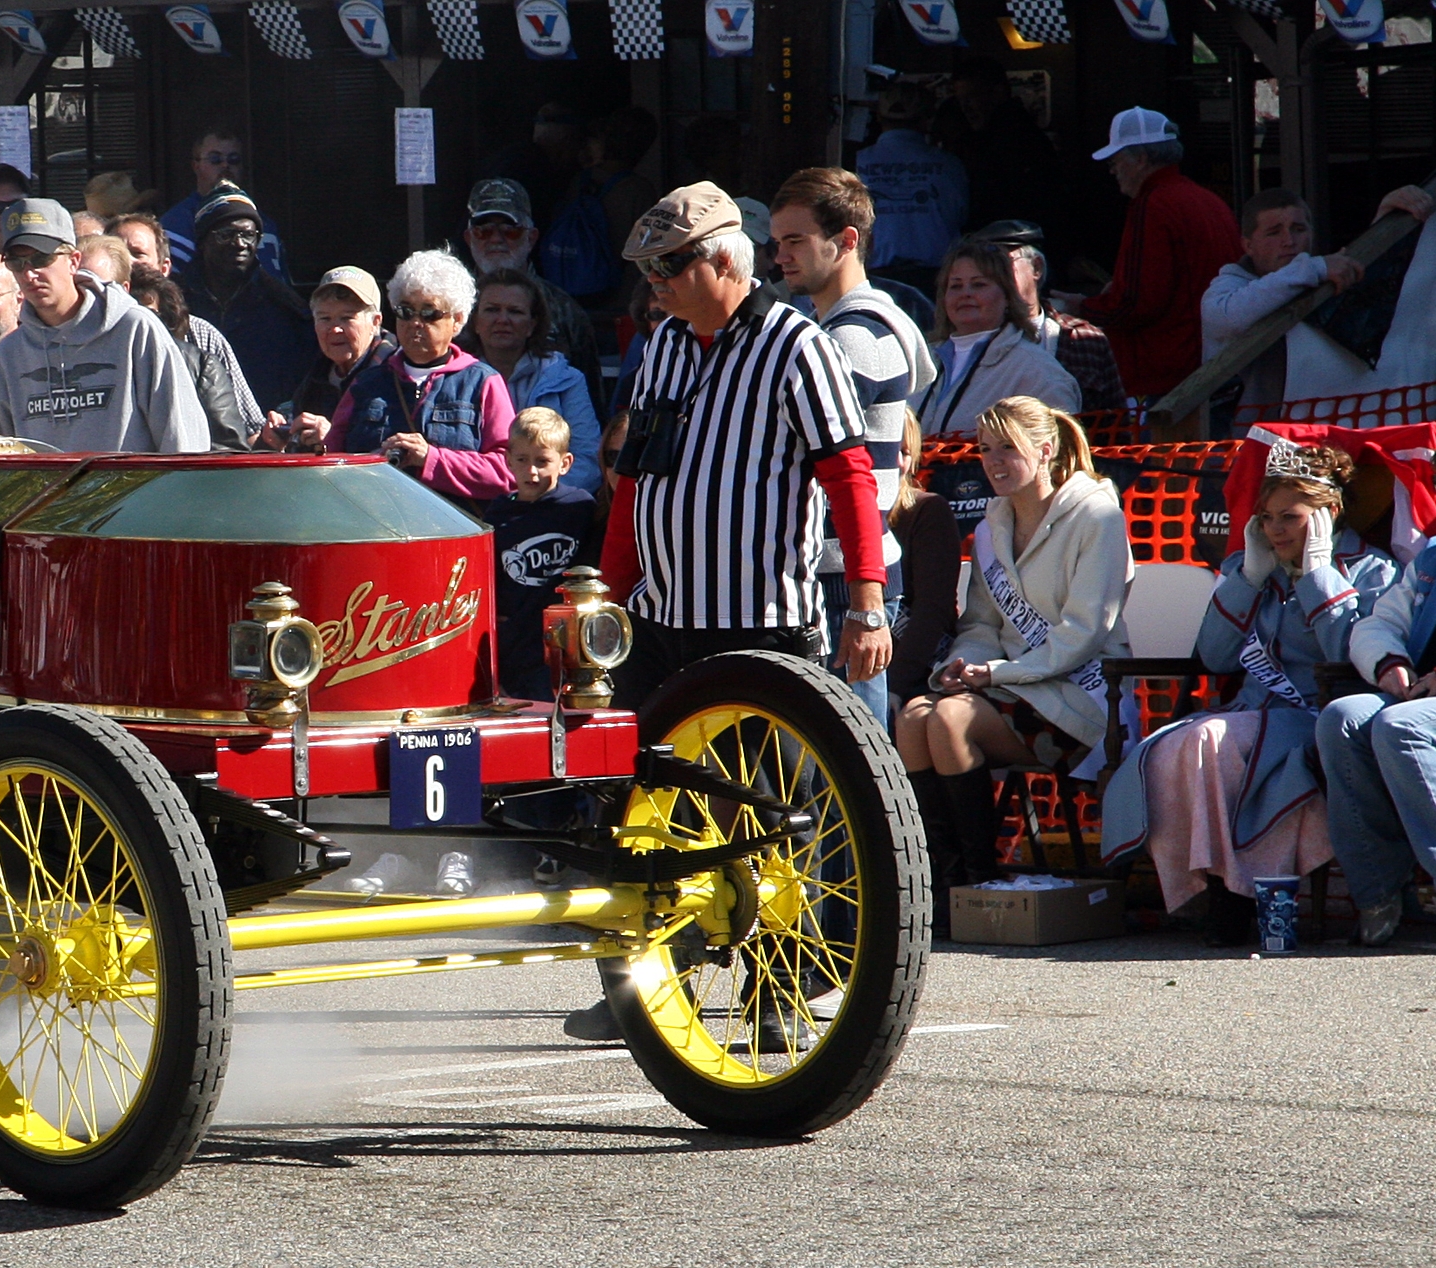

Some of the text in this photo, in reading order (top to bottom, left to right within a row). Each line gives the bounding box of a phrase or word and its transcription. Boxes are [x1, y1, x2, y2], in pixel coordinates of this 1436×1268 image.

[715, 33, 749, 43] Valvoline
[27, 392, 105, 414] CHEVROLET
[948, 496, 993, 511] CTORY
[321, 556, 482, 686] Stanley
[1241, 649, 1287, 688] QUEEN
[399, 732, 472, 749] PENNA 1906
[425, 754, 445, 822] 6
